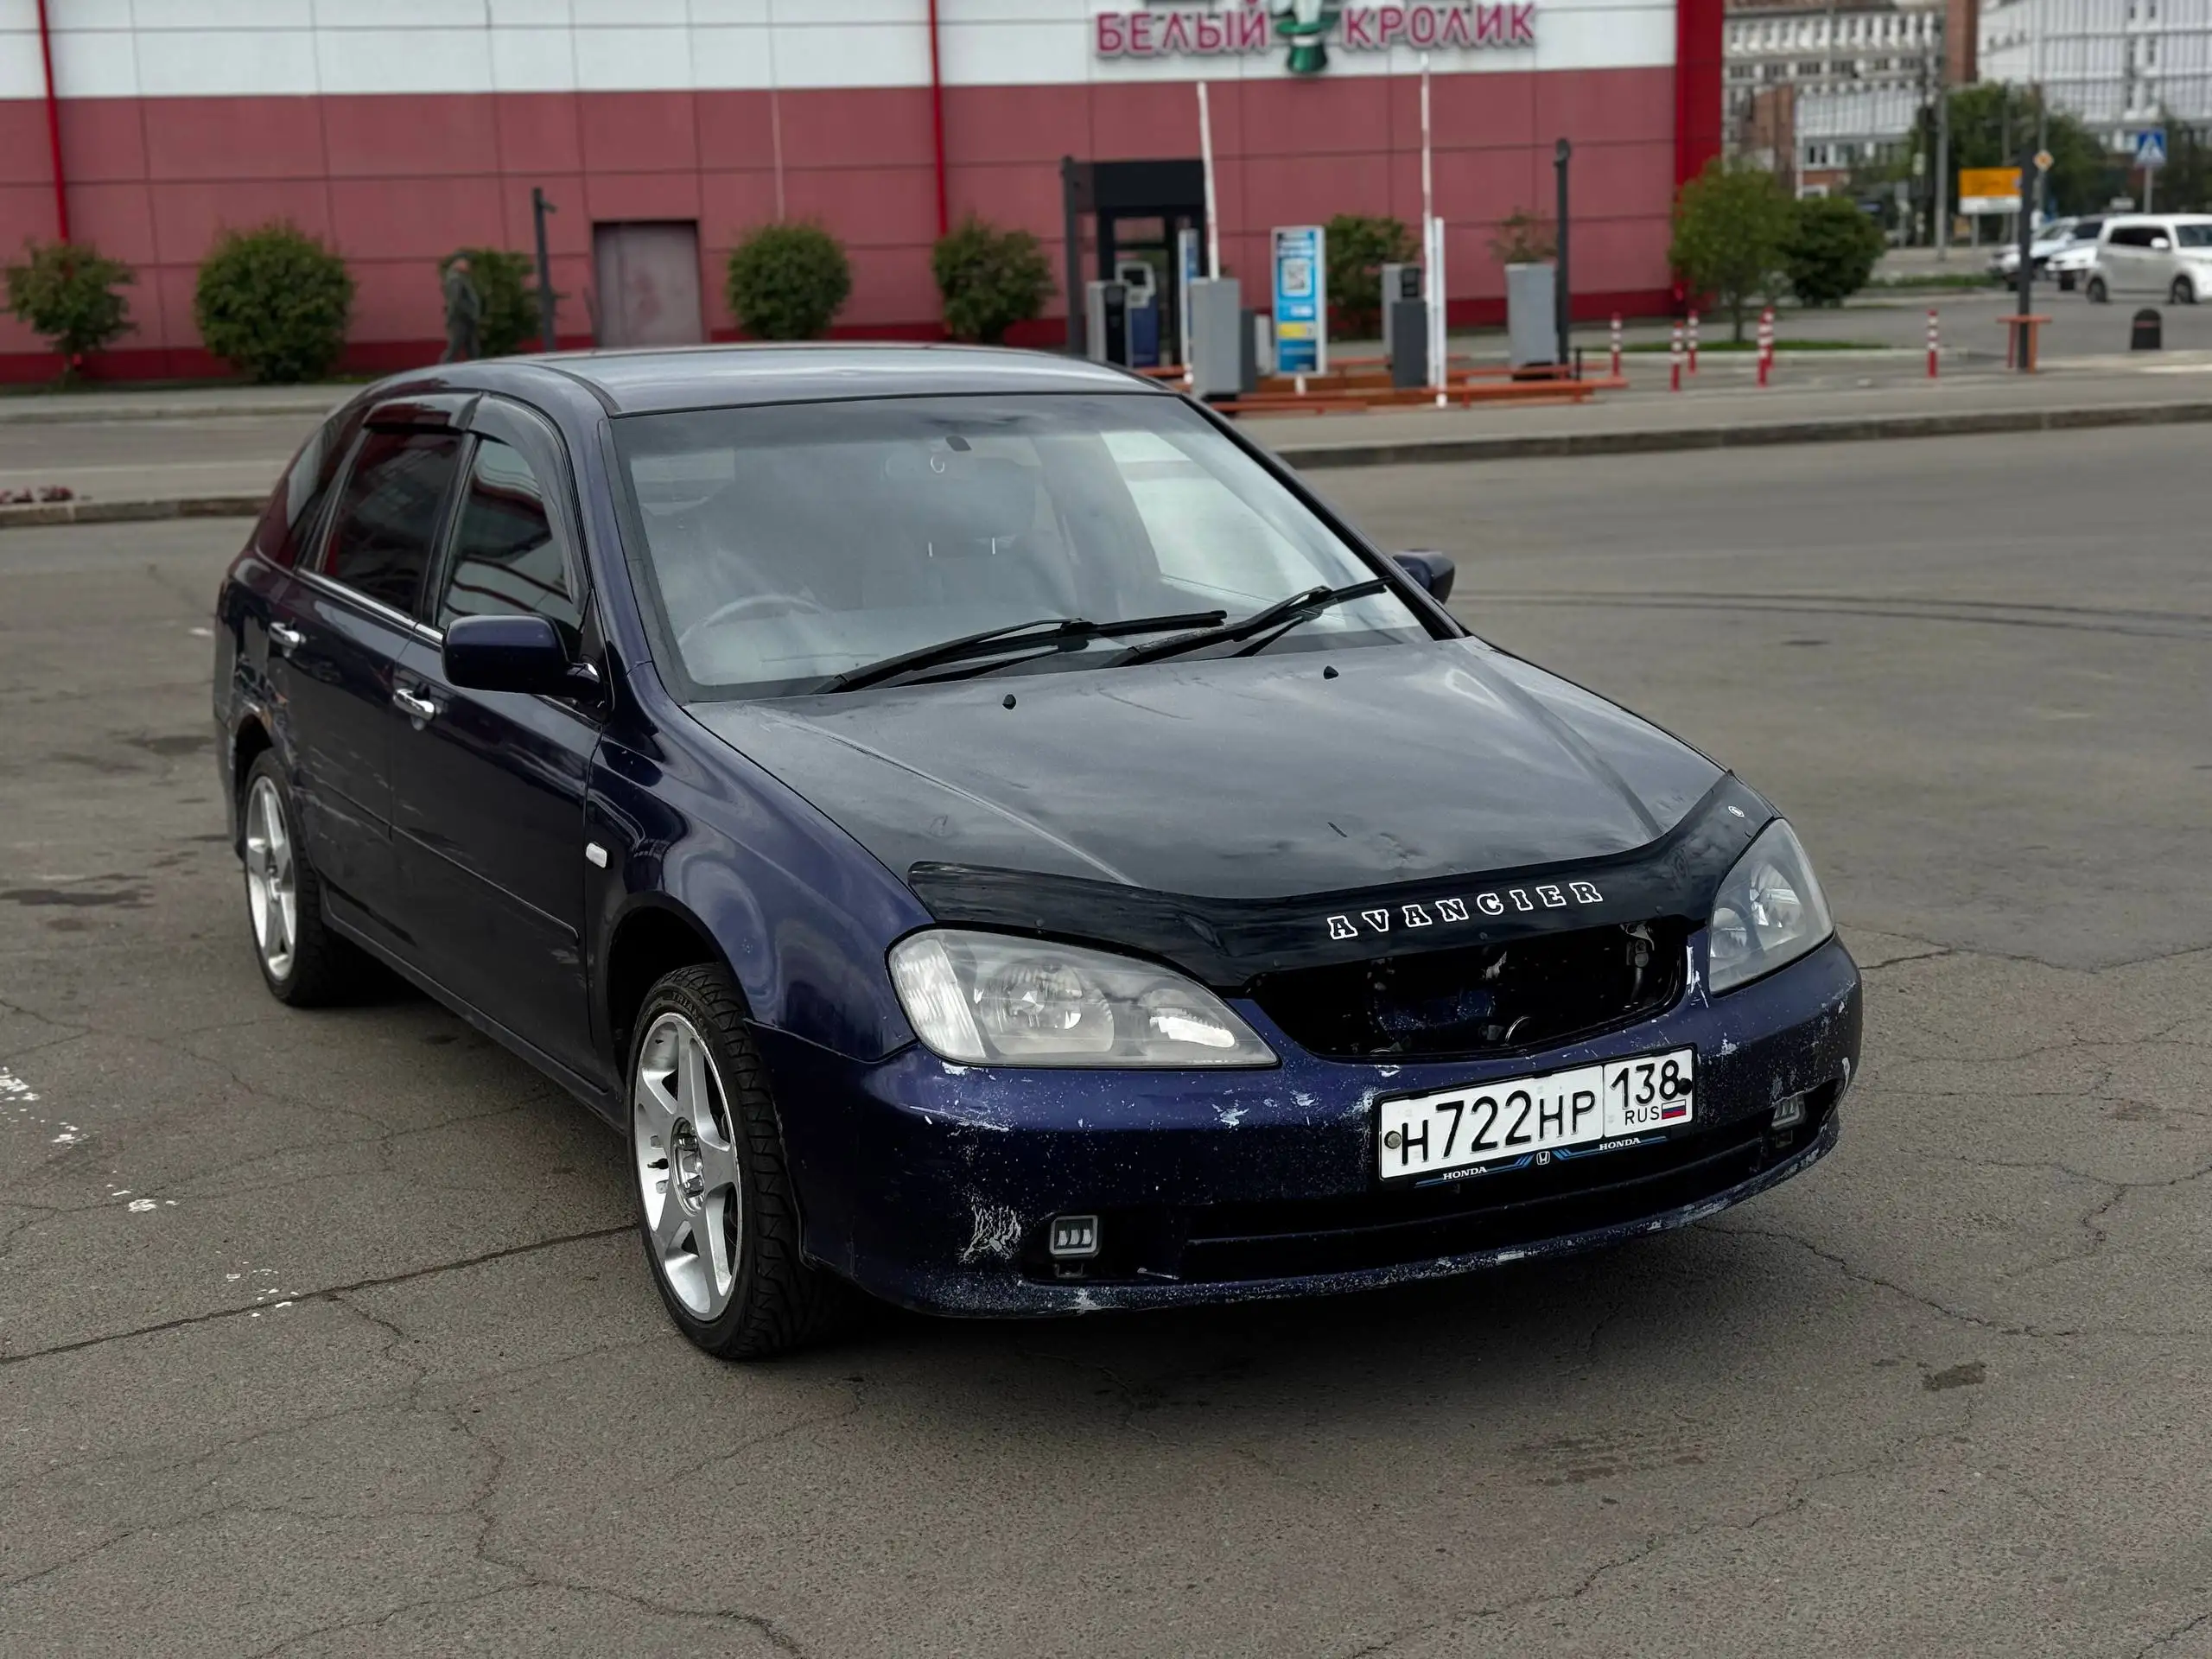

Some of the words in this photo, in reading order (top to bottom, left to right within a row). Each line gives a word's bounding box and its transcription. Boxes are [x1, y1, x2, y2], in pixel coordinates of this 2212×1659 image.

[1095, 0, 1270, 53] БЕЛЫЙ
[1344, 4, 1536, 44] КРОЛИК
[1326, 881, 1604, 940] AVANCIER
[1611, 1059, 1681, 1109] 138
[1624, 1106, 1661, 1126] RUS
[1599, 1137, 1642, 1152] HONDA
[1442, 1166, 1488, 1181] HONDA
